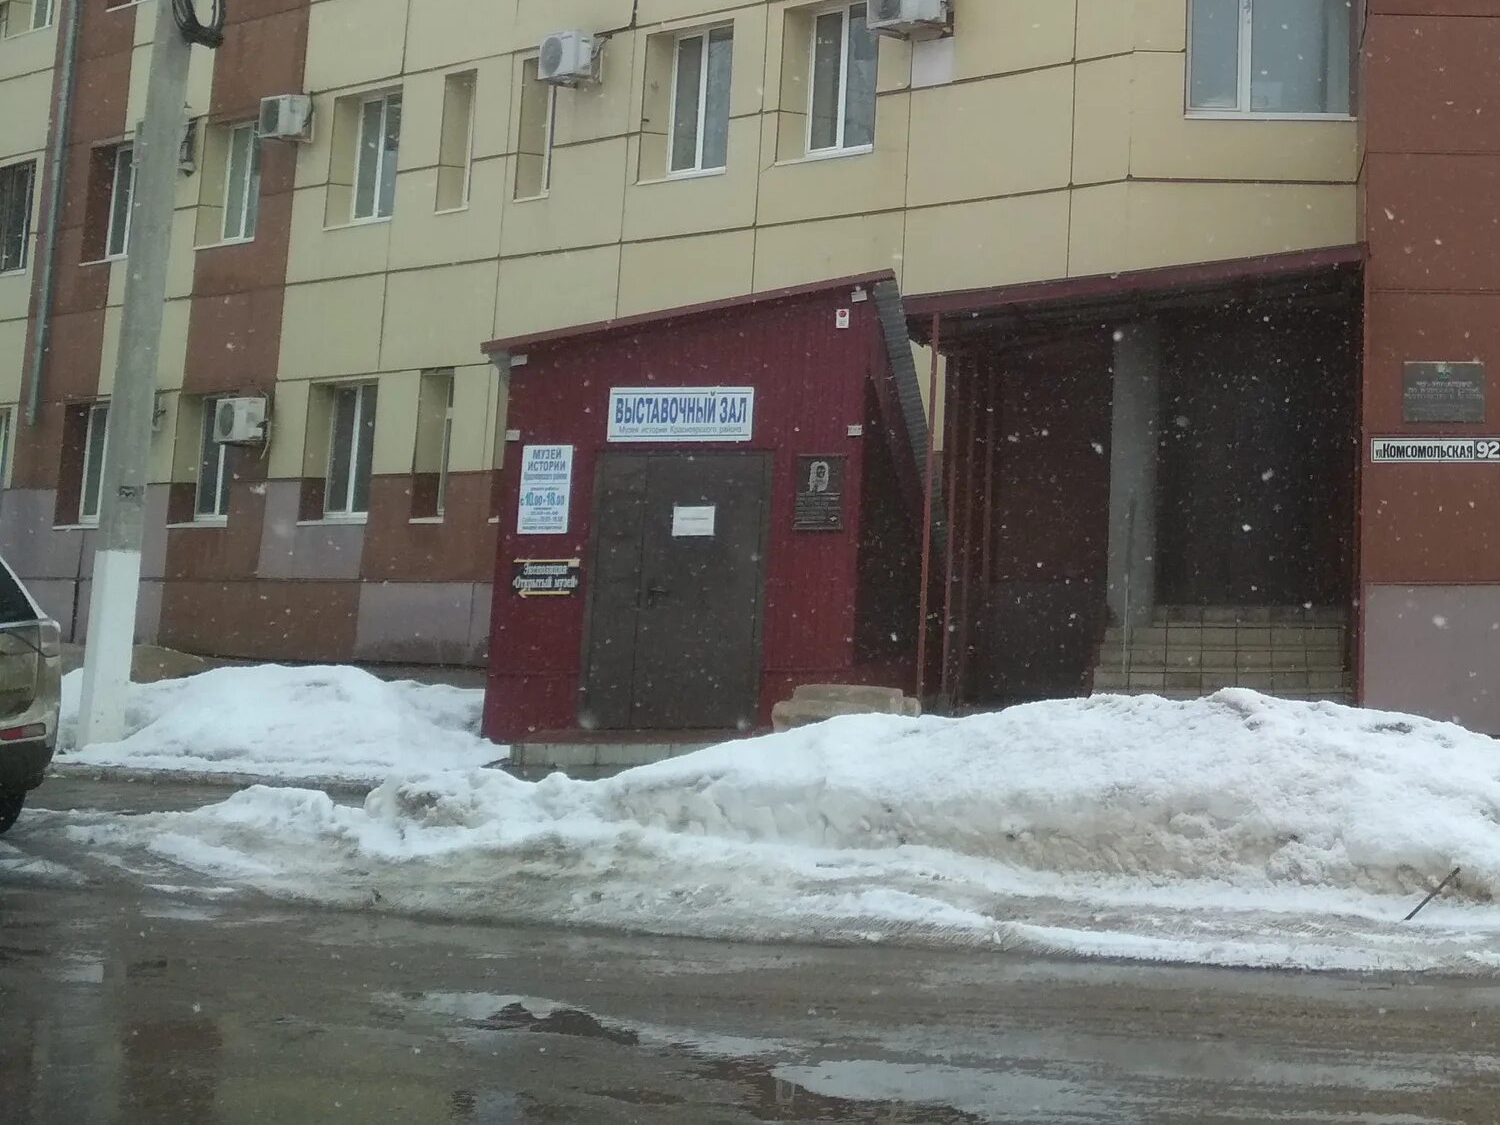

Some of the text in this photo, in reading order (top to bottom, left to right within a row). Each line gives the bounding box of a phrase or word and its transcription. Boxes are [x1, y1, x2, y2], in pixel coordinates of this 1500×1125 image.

[615, 391, 747, 424] ВЫСТАВОЧНЫЙ ЗАЛ
[533, 448, 562, 460] МУЗЕЙ
[1383, 443, 1473, 459] КОМСОМОЛЬСКАЯ
[528, 460, 566, 472] ИСТОРИИ
